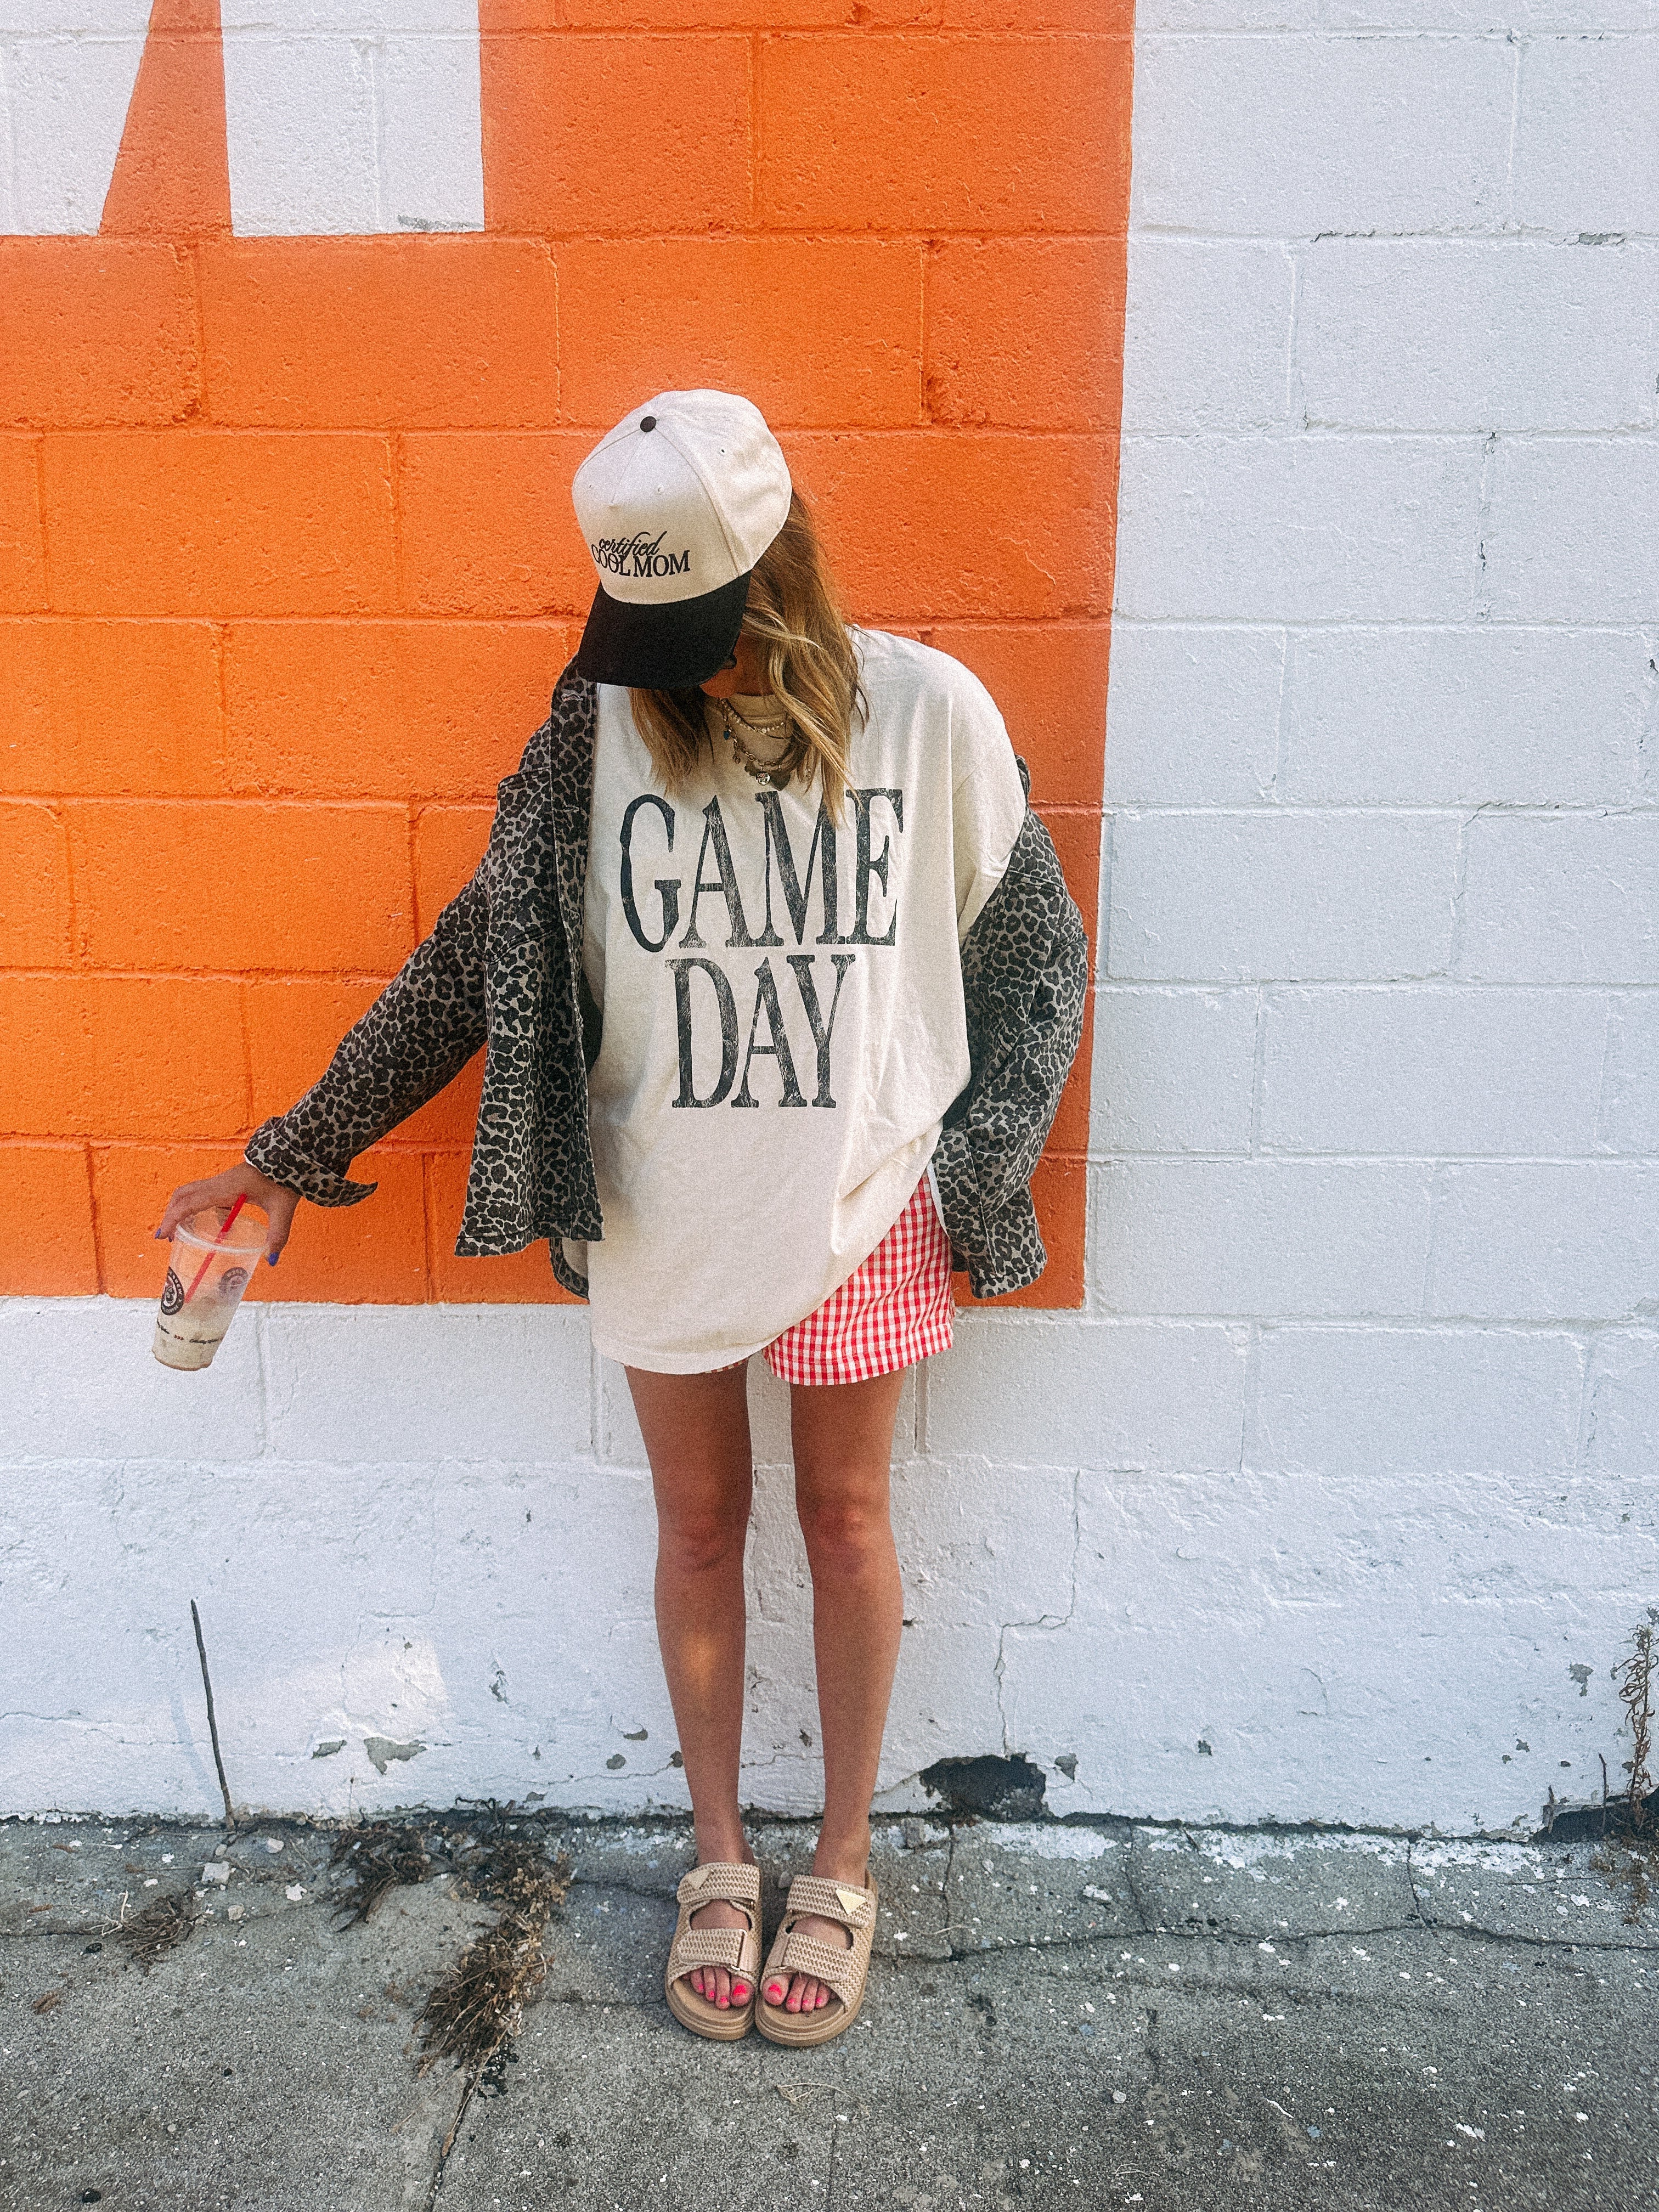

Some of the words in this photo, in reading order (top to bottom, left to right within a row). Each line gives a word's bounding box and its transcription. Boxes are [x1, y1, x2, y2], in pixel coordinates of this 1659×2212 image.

[591, 544, 630, 577] COOL
[633, 549, 691, 578] MOM
[599, 531, 668, 561] certified
[620, 787, 904, 953] GAME
[664, 953, 856, 1109] DAY
